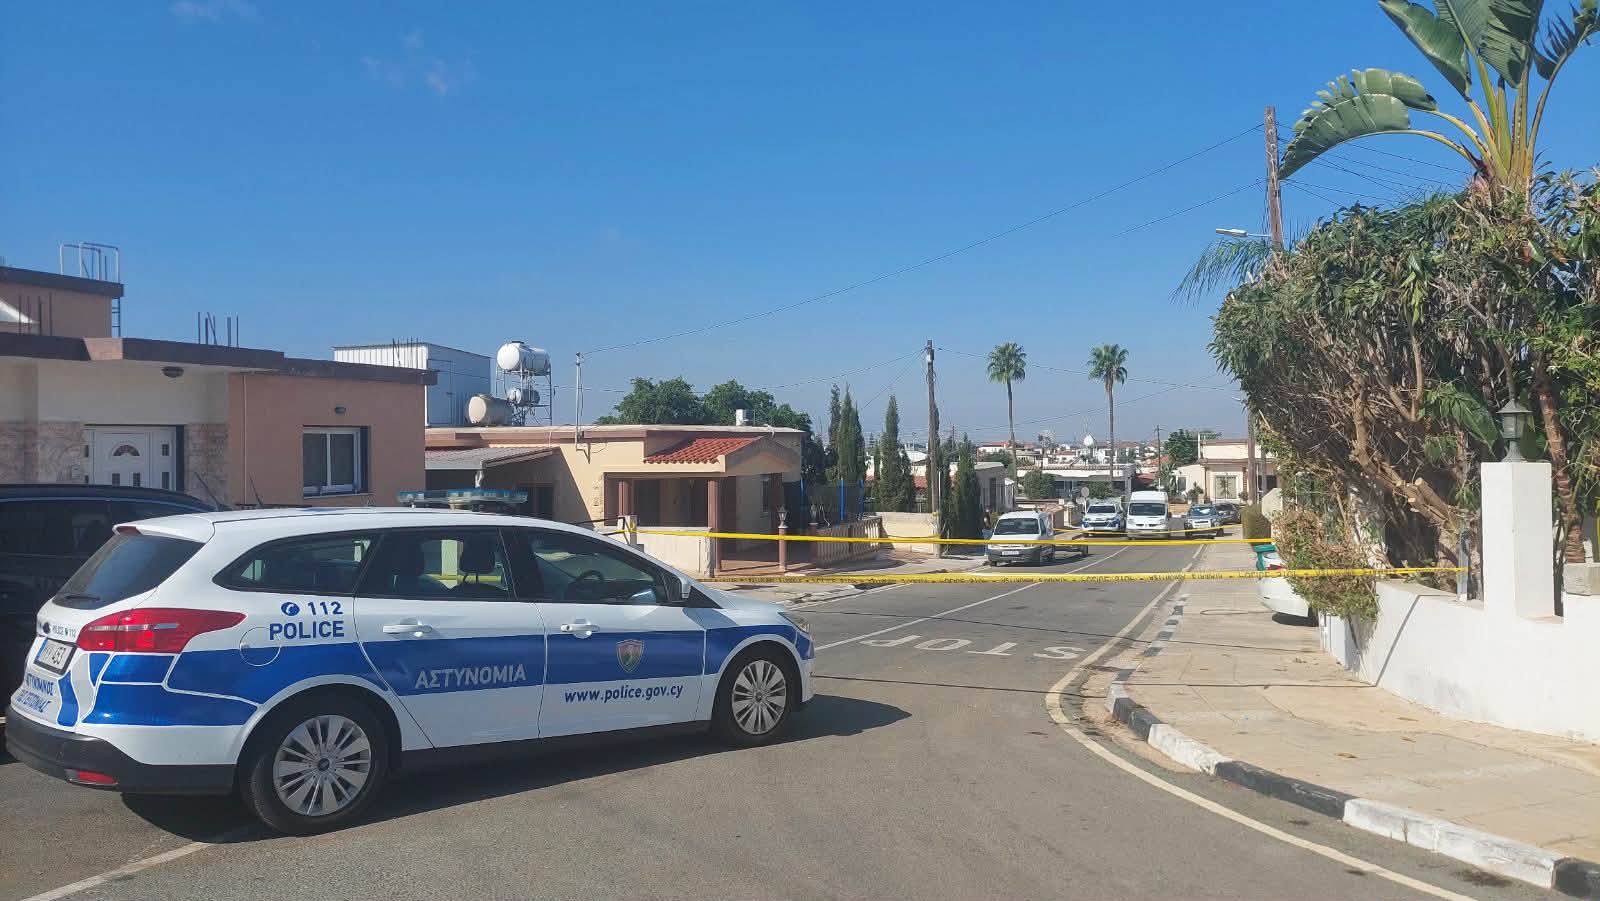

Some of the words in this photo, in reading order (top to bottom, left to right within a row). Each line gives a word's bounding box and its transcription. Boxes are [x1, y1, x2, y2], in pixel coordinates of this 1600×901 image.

[308, 601, 344, 616] 112
[269, 620, 345, 640] POLICE
[858, 635, 1087, 660] STOP
[414, 663, 527, 689] ΑΣΤΥΝΟΜΙΑ
[564, 684, 683, 704] www.police.gov.cy
